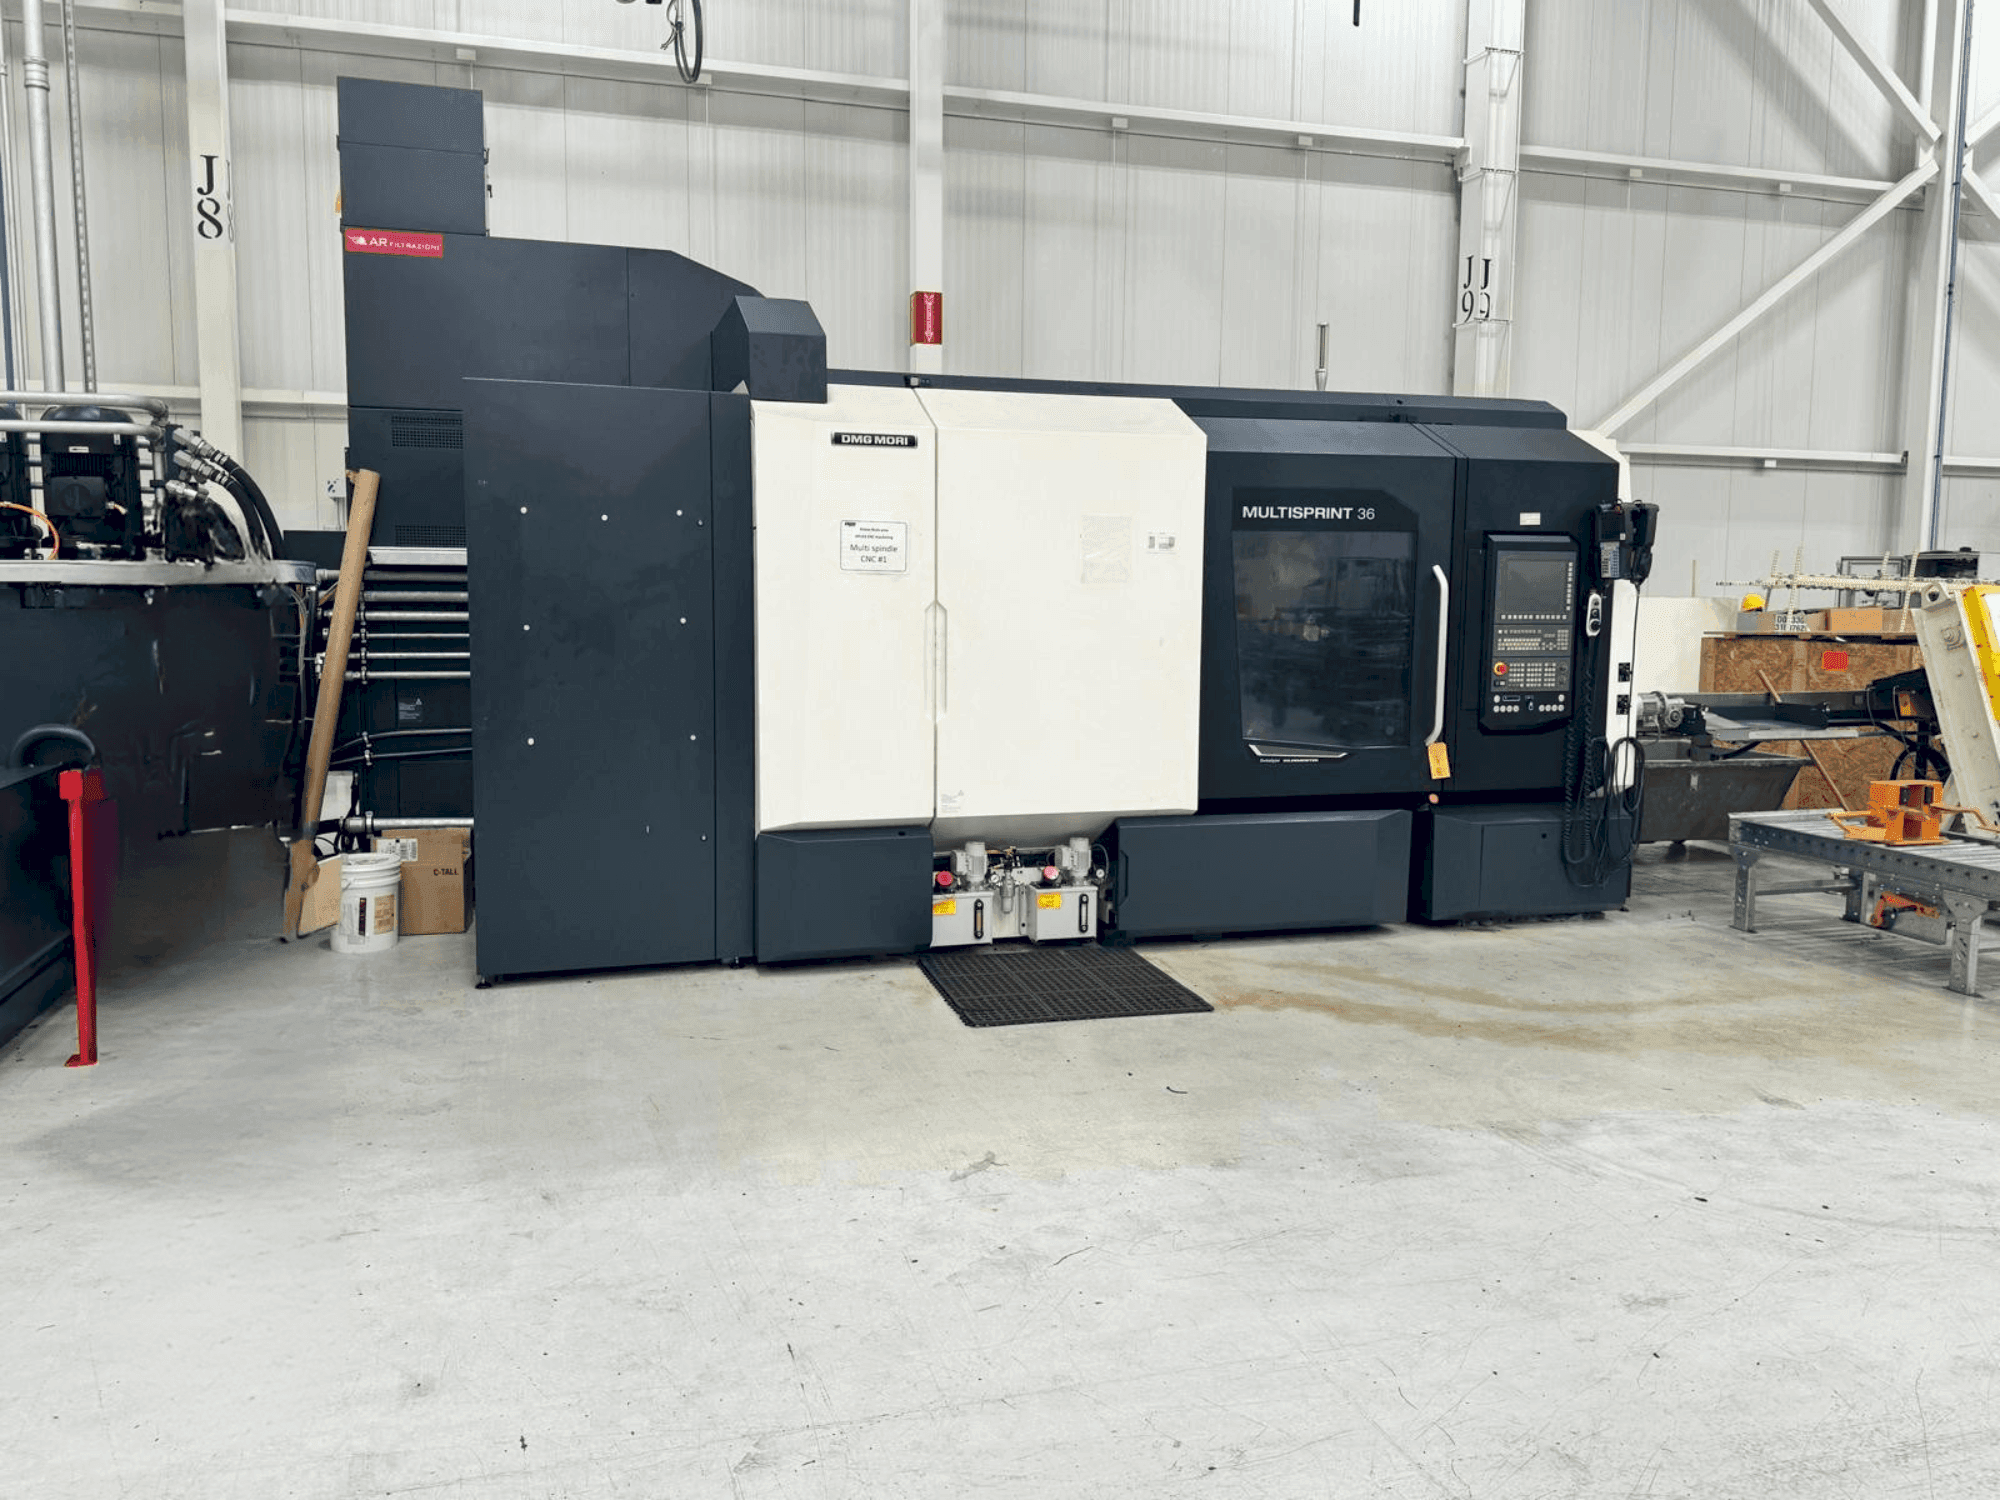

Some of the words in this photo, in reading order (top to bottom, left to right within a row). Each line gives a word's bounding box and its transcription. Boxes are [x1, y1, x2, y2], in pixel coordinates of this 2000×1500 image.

[197, 154, 219, 195] J
[197, 197, 223, 239] 8
[369, 236, 388, 247] AR
[1463, 255, 1475, 290] J
[1461, 290, 1475, 323] 9
[841, 434, 873, 445] DMG
[874, 435, 909, 446] MORI
[1242, 505, 1354, 520] MULTISPRINT
[1357, 507, 1376, 520] 36
[850, 543, 870, 551] Multi
[871, 544, 898, 553] spindle
[860, 554, 876, 563] CNC
[878, 555, 887, 564] #1
